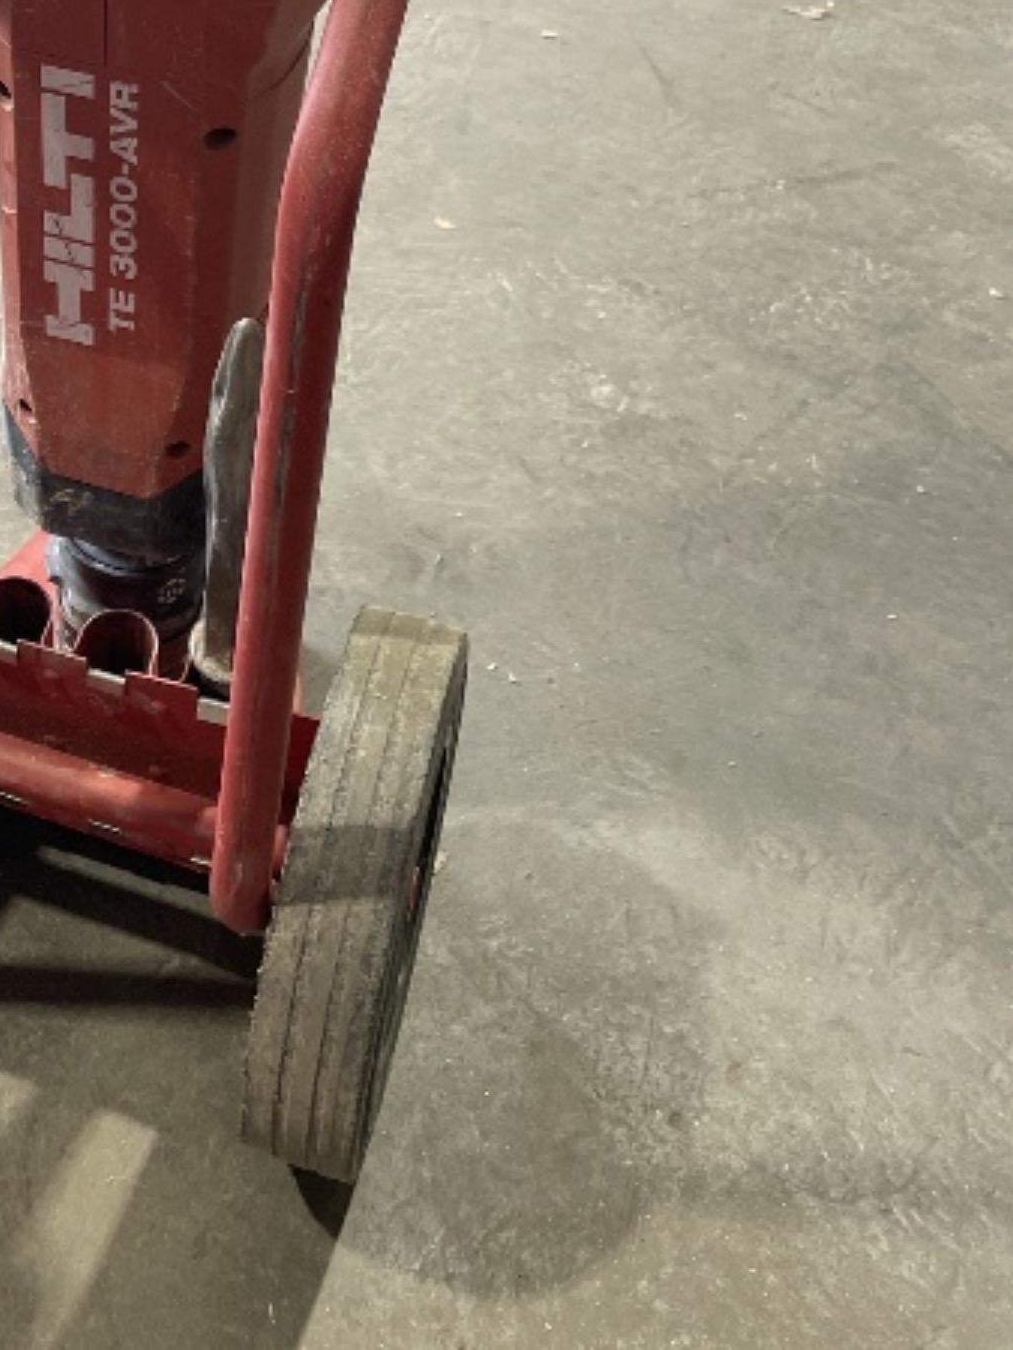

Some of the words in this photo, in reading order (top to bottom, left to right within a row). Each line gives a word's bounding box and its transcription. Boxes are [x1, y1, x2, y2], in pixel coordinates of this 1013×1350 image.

[41, 63, 96, 347] HILTI
[108, 79, 141, 281] 3000-AVR
[107, 287, 136, 334] TE
